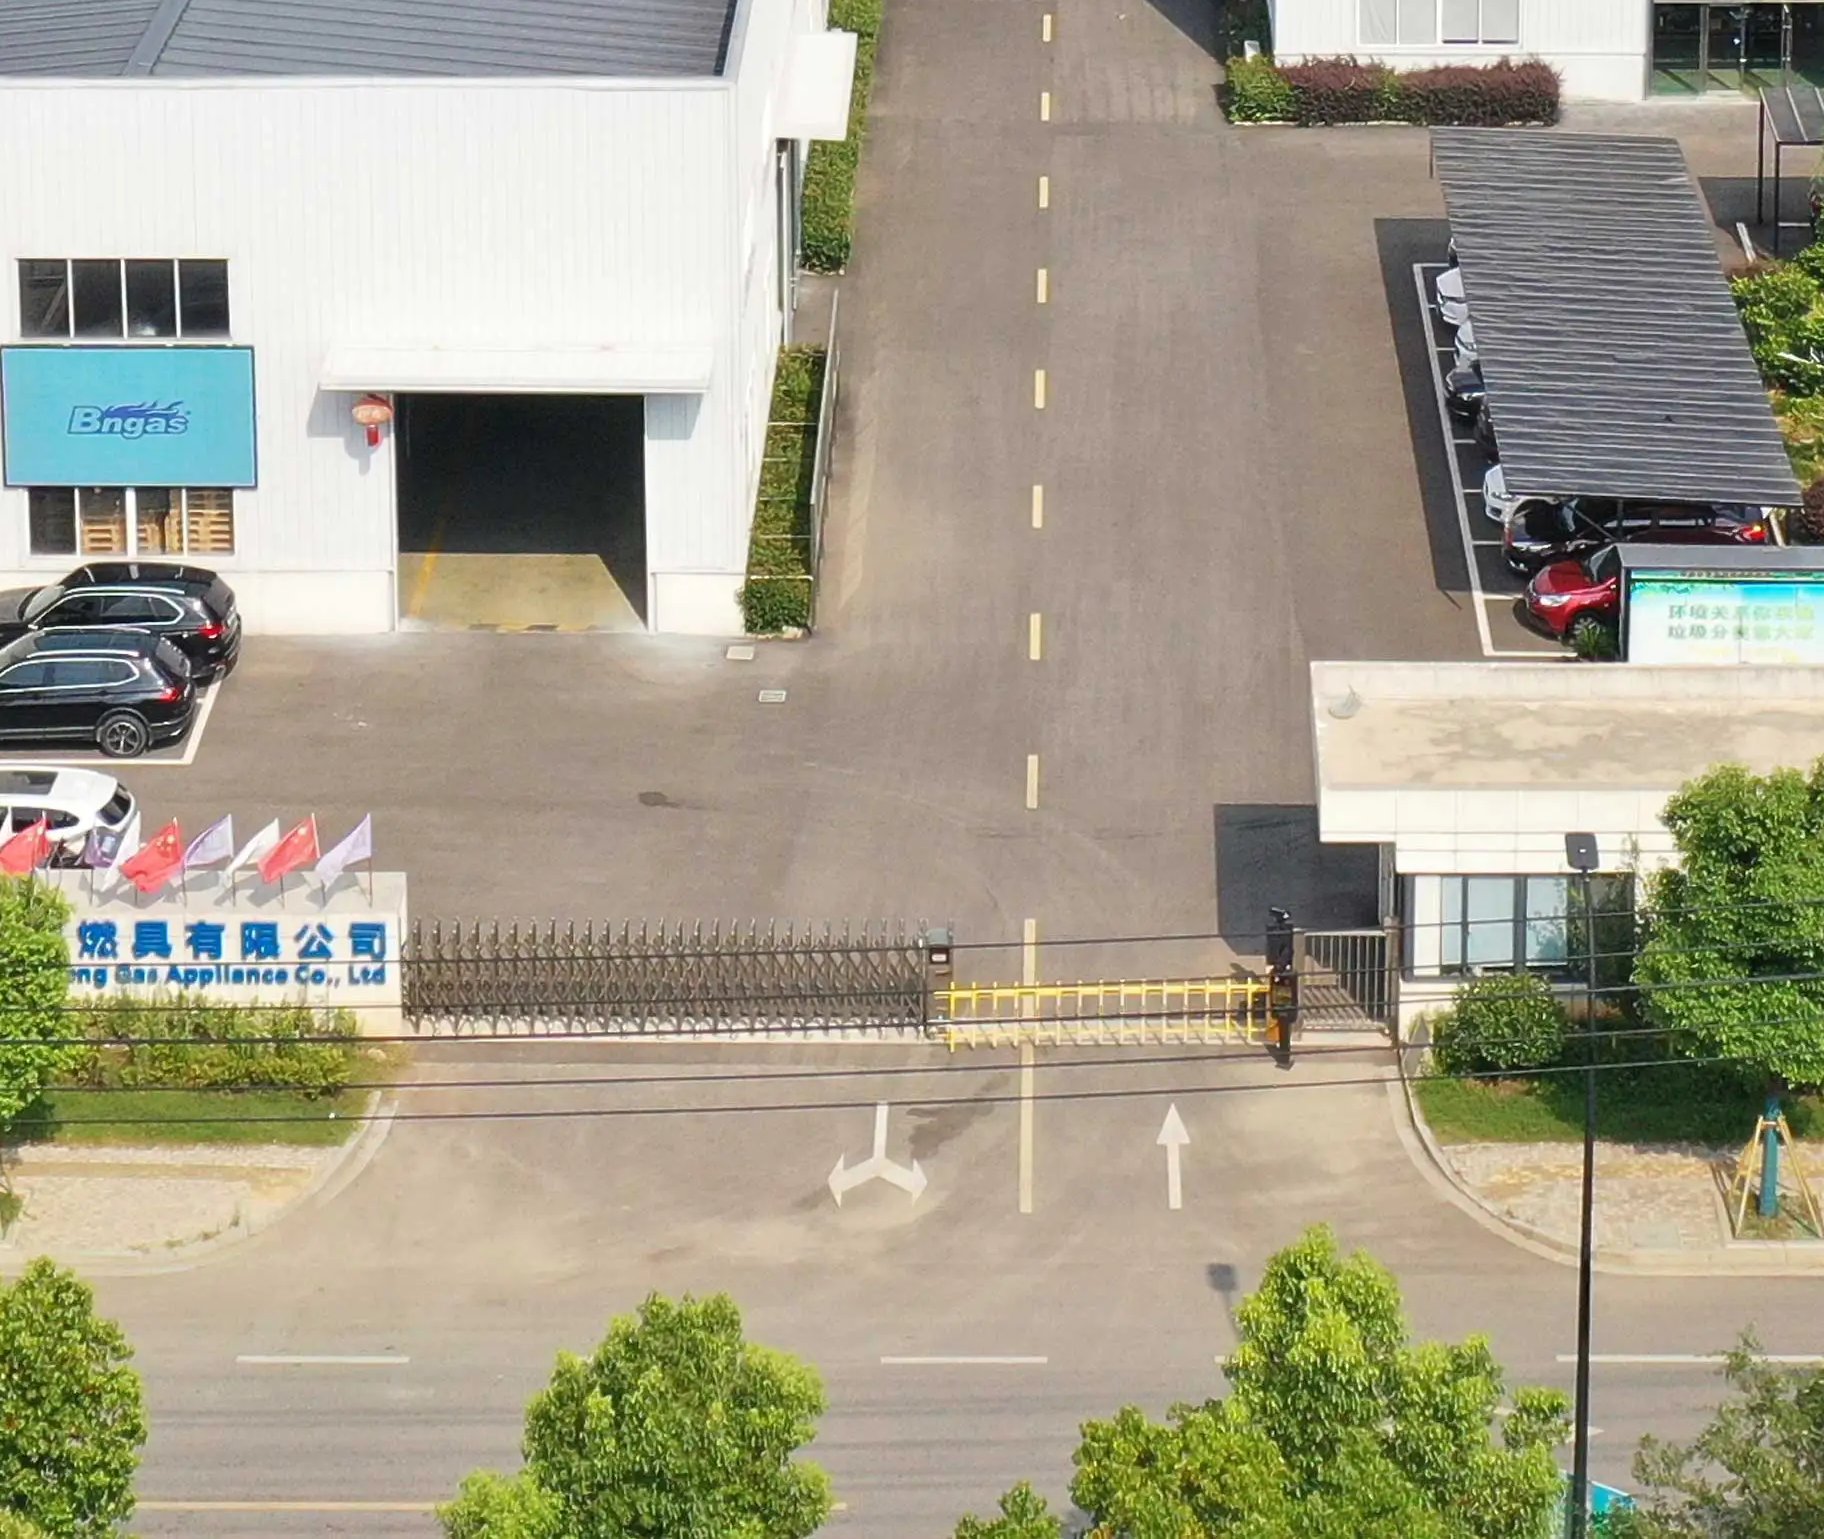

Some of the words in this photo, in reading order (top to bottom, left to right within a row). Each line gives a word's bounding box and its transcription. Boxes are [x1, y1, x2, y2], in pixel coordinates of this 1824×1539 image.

[67, 404, 189, 440] Bngas
[114, 964, 157, 985] Gas
[164, 963, 288, 989] Appliance
[347, 963, 386, 985] Ltd
